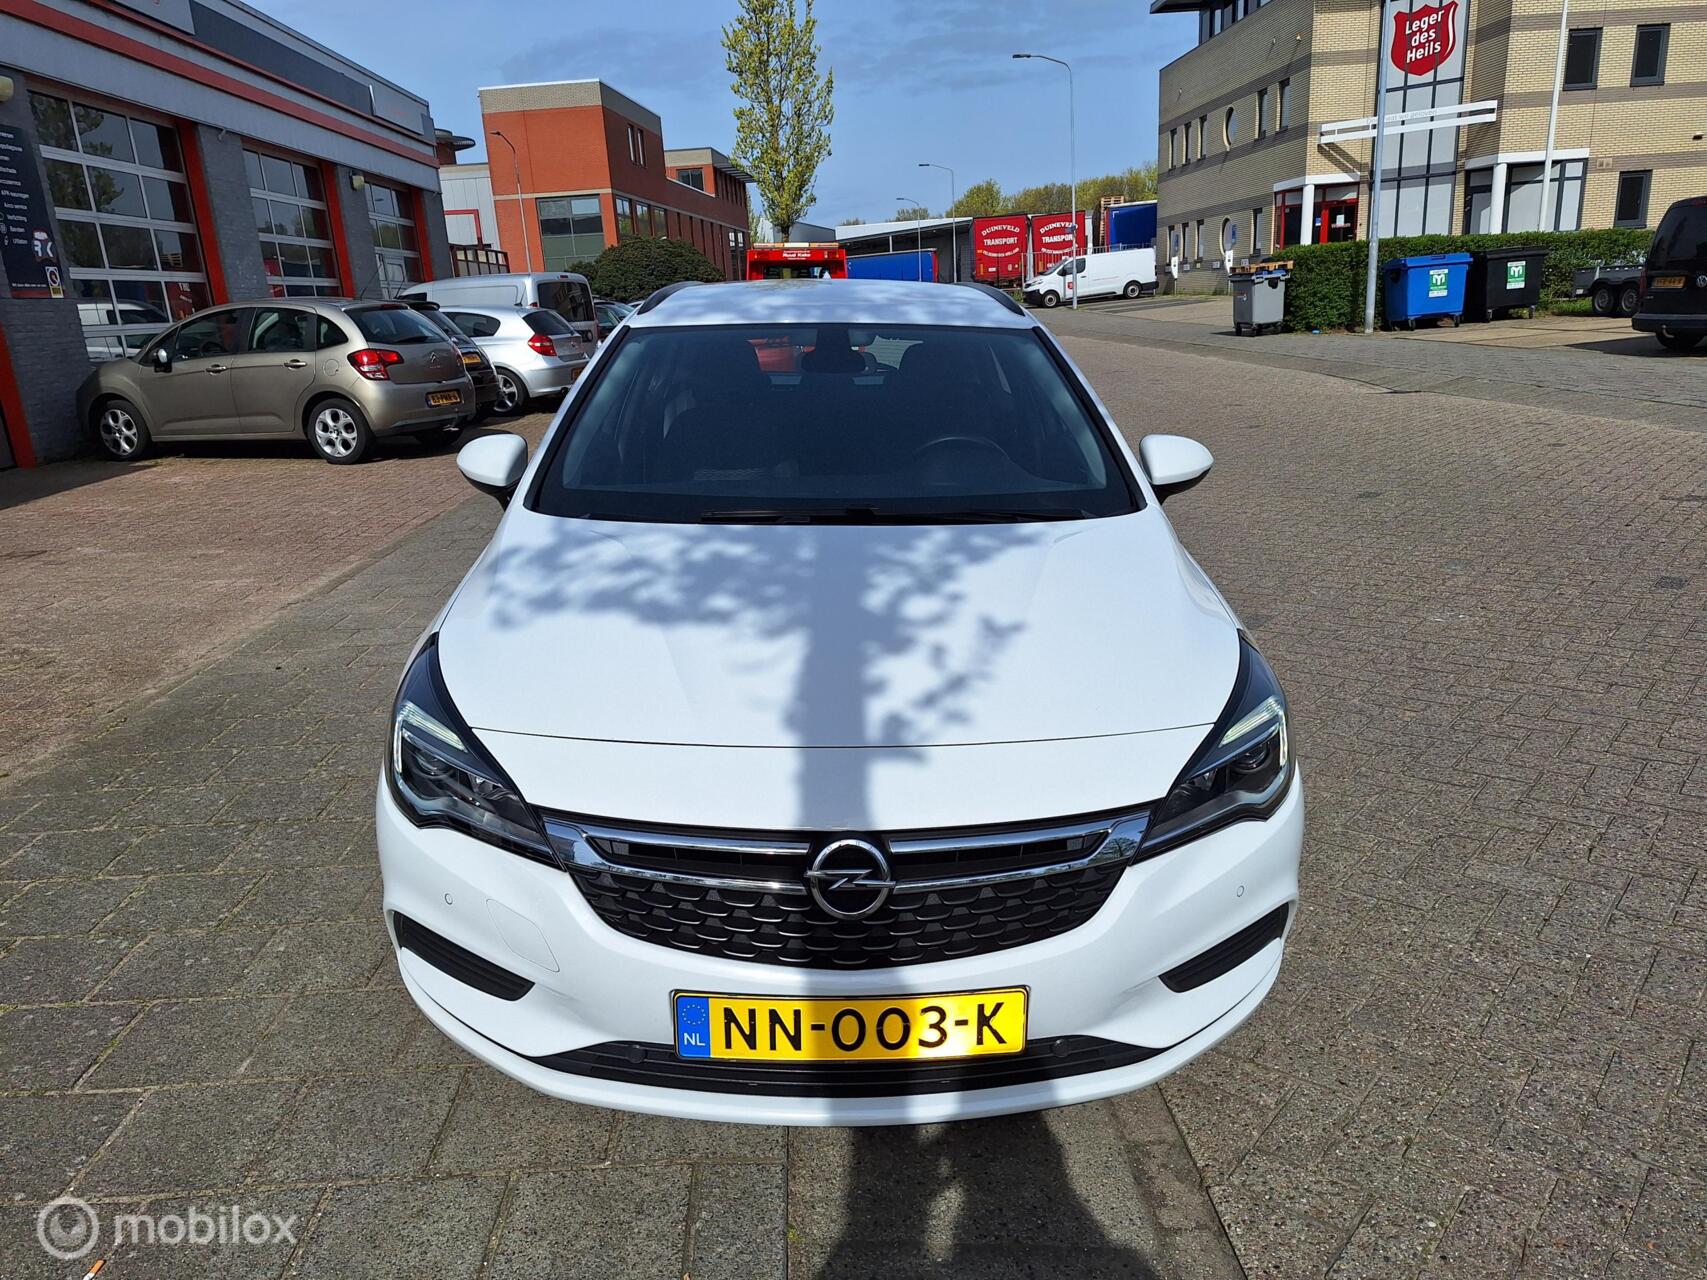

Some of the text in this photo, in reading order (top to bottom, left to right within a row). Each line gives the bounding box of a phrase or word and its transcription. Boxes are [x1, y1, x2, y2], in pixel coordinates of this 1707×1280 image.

[1405, 10, 1444, 35] Leger
[1411, 29, 1436, 46] des
[1406, 41, 1441, 63] Heils
[981, 224, 1020, 236] DUINEVELD
[1041, 233, 1076, 243] TRANSPOR
[983, 237, 1018, 246] TRANSPORT
[723, 1002, 1007, 1051] NN-003-K
[683, 1032, 706, 1047] NL
